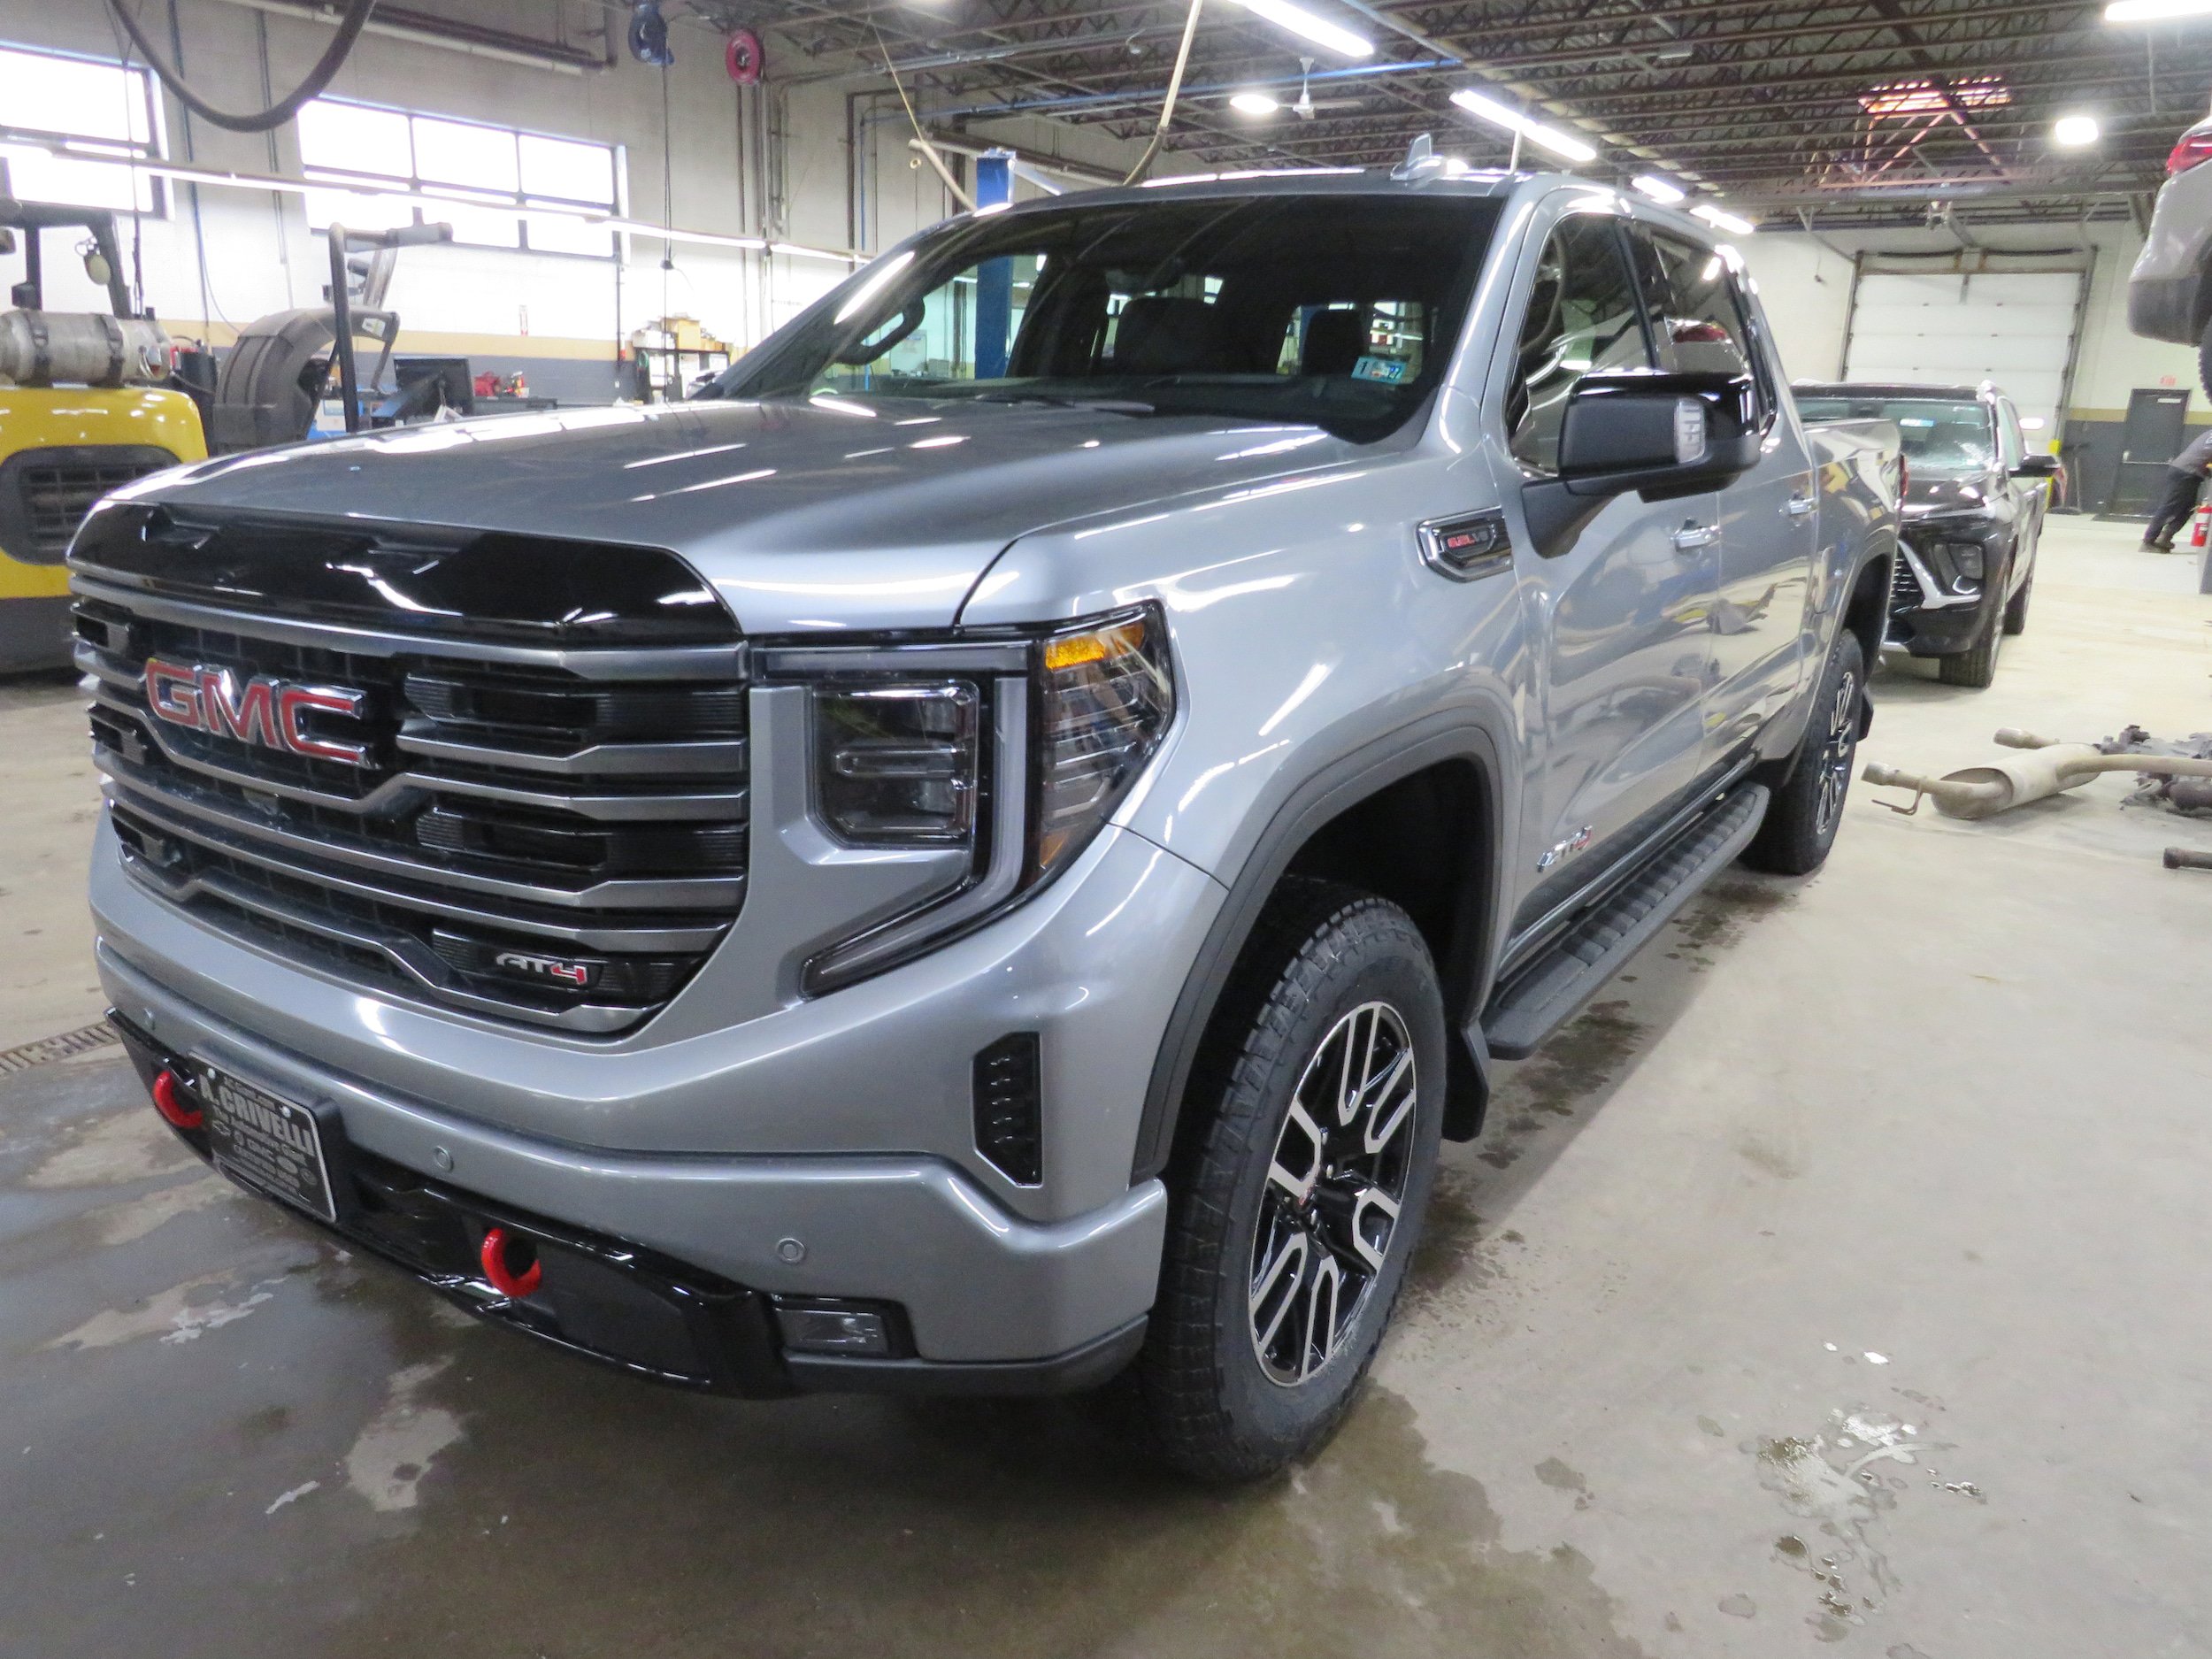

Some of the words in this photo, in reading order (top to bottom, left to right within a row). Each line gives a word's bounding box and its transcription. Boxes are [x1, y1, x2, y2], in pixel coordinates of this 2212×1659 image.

[144, 659, 365, 766] GMC
[495, 953, 588, 986] AT4
[219, 1085, 316, 1157] CRIVELLI
